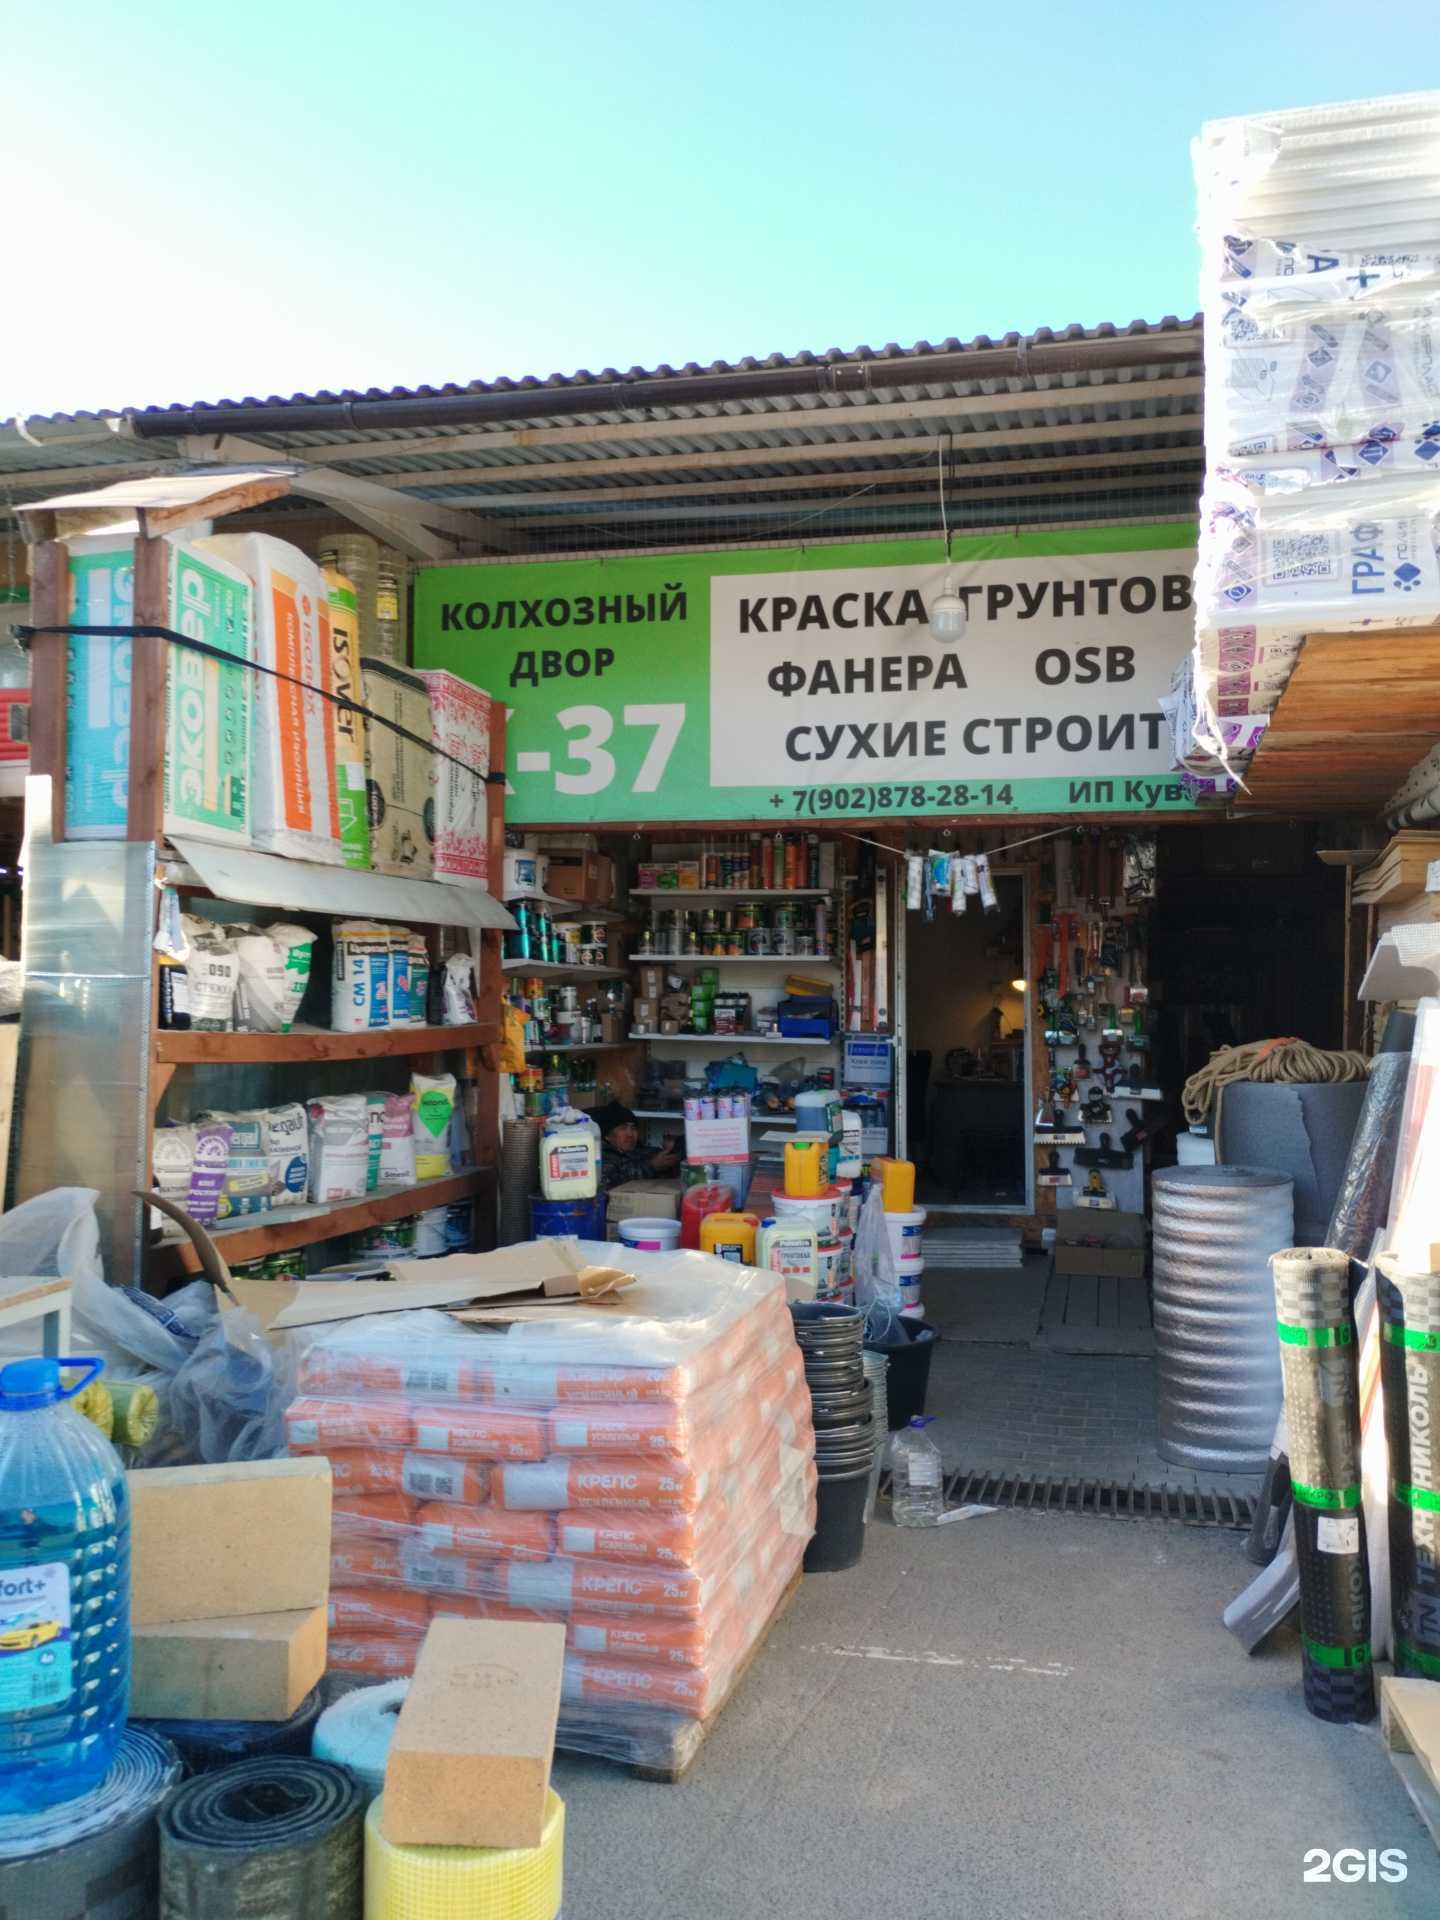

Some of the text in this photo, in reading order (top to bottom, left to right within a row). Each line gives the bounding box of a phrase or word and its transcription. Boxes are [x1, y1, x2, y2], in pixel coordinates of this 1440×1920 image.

[441, 582, 688, 631] КОЛХОЗНЫЙ
[738, 574, 1193, 633] КРАСКА ГРУНТОВ
[509, 647, 615, 688] ДВОР
[767, 652, 968, 698] ФАНЕРА
[1035, 646, 1136, 685] OSB
[505, 702, 686, 796] -37
[785, 712, 1167, 762] СУХИЕ СТРОИТ
[1069, 781, 1114, 804] ИП
[577, 1473, 639, 1490] КРЕПС
[1407, 1362, 1437, 1585] ТЕХННИКОЛЬ
